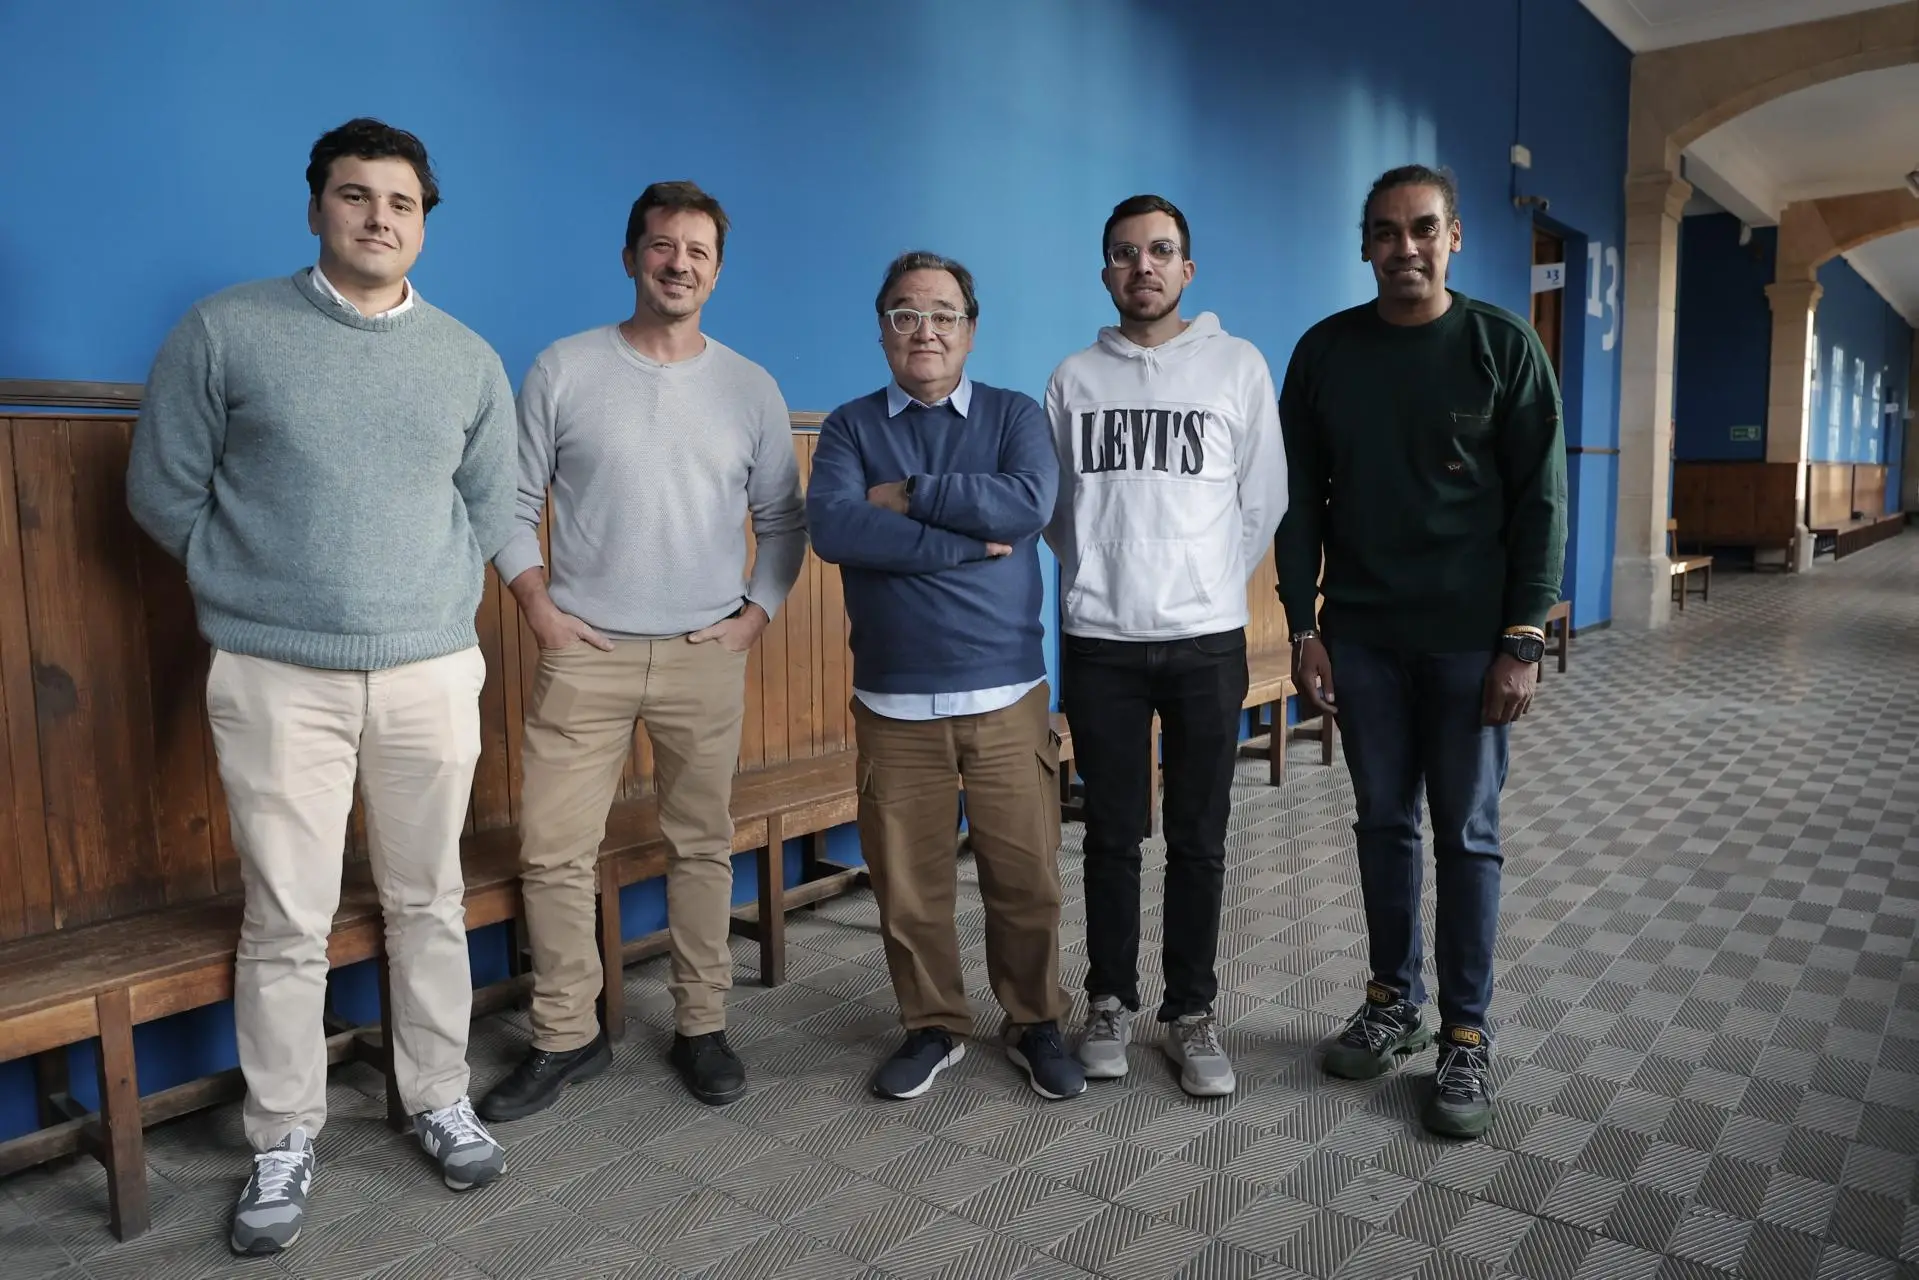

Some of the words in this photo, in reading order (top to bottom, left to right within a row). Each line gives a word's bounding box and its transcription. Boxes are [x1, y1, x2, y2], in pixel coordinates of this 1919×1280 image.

[1545, 269, 1559, 281] 13
[1587, 241, 1620, 350] 13
[1081, 409, 1205, 475] LEVI'S
